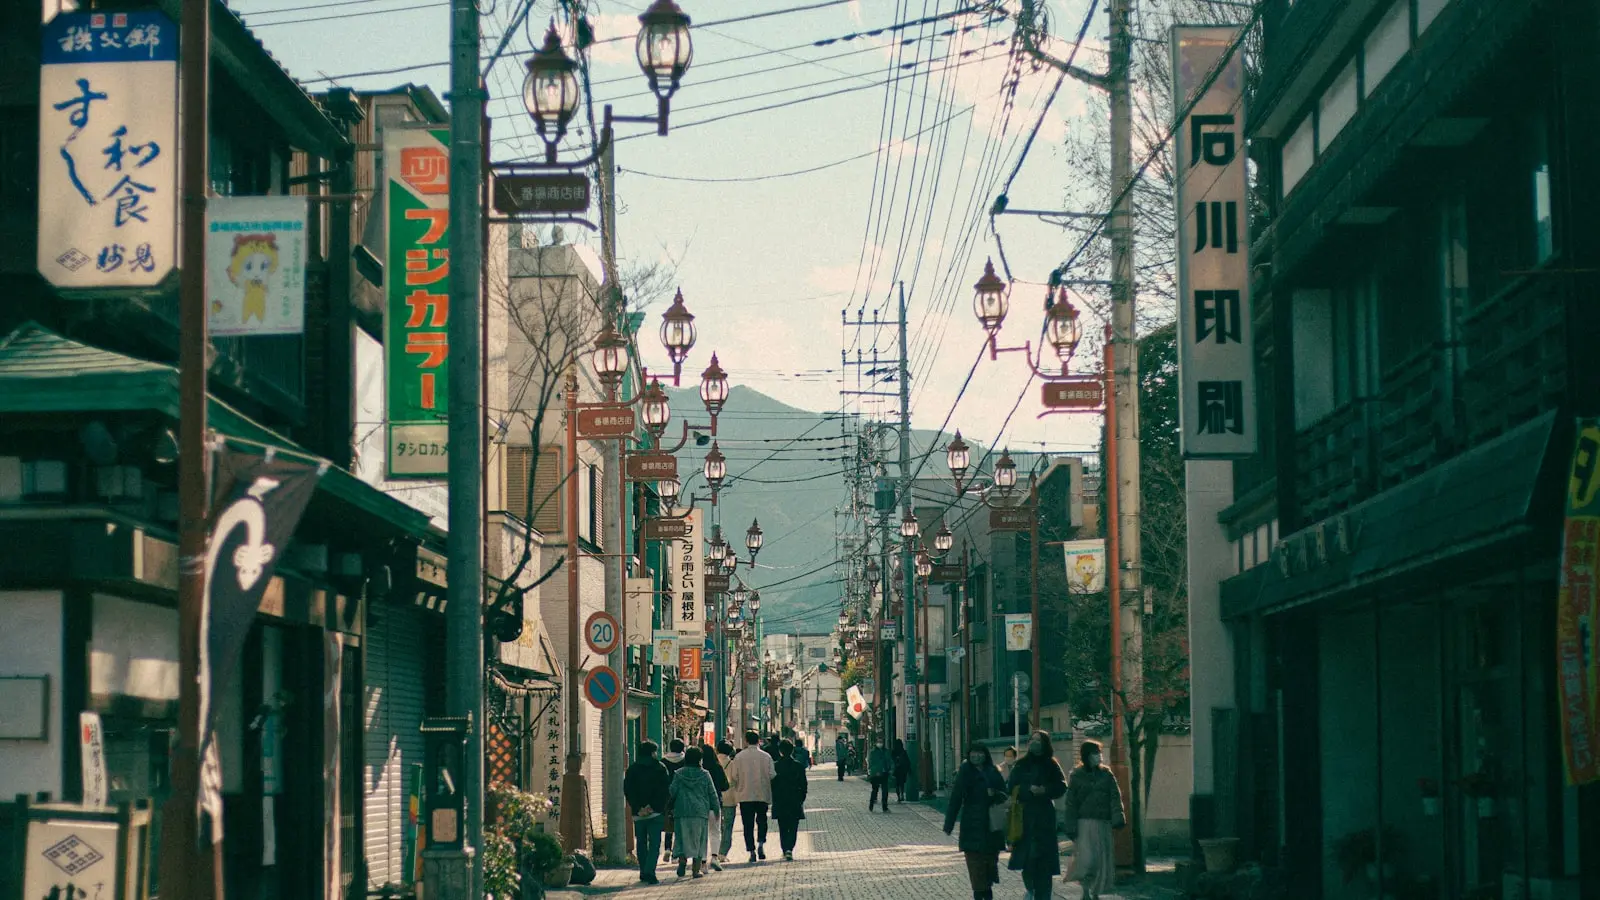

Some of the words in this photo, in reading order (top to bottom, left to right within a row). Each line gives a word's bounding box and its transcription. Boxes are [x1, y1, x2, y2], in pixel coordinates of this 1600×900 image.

[58, 23, 160, 58] 秩父錦
[53, 78, 107, 206] すし
[102, 125, 160, 228] 和食
[404, 208, 449, 409] フジカラー
[1189, 114, 1243, 435] 石川印刷
[592, 623, 612, 643] 20
[681, 592, 694, 621] 屋根材
